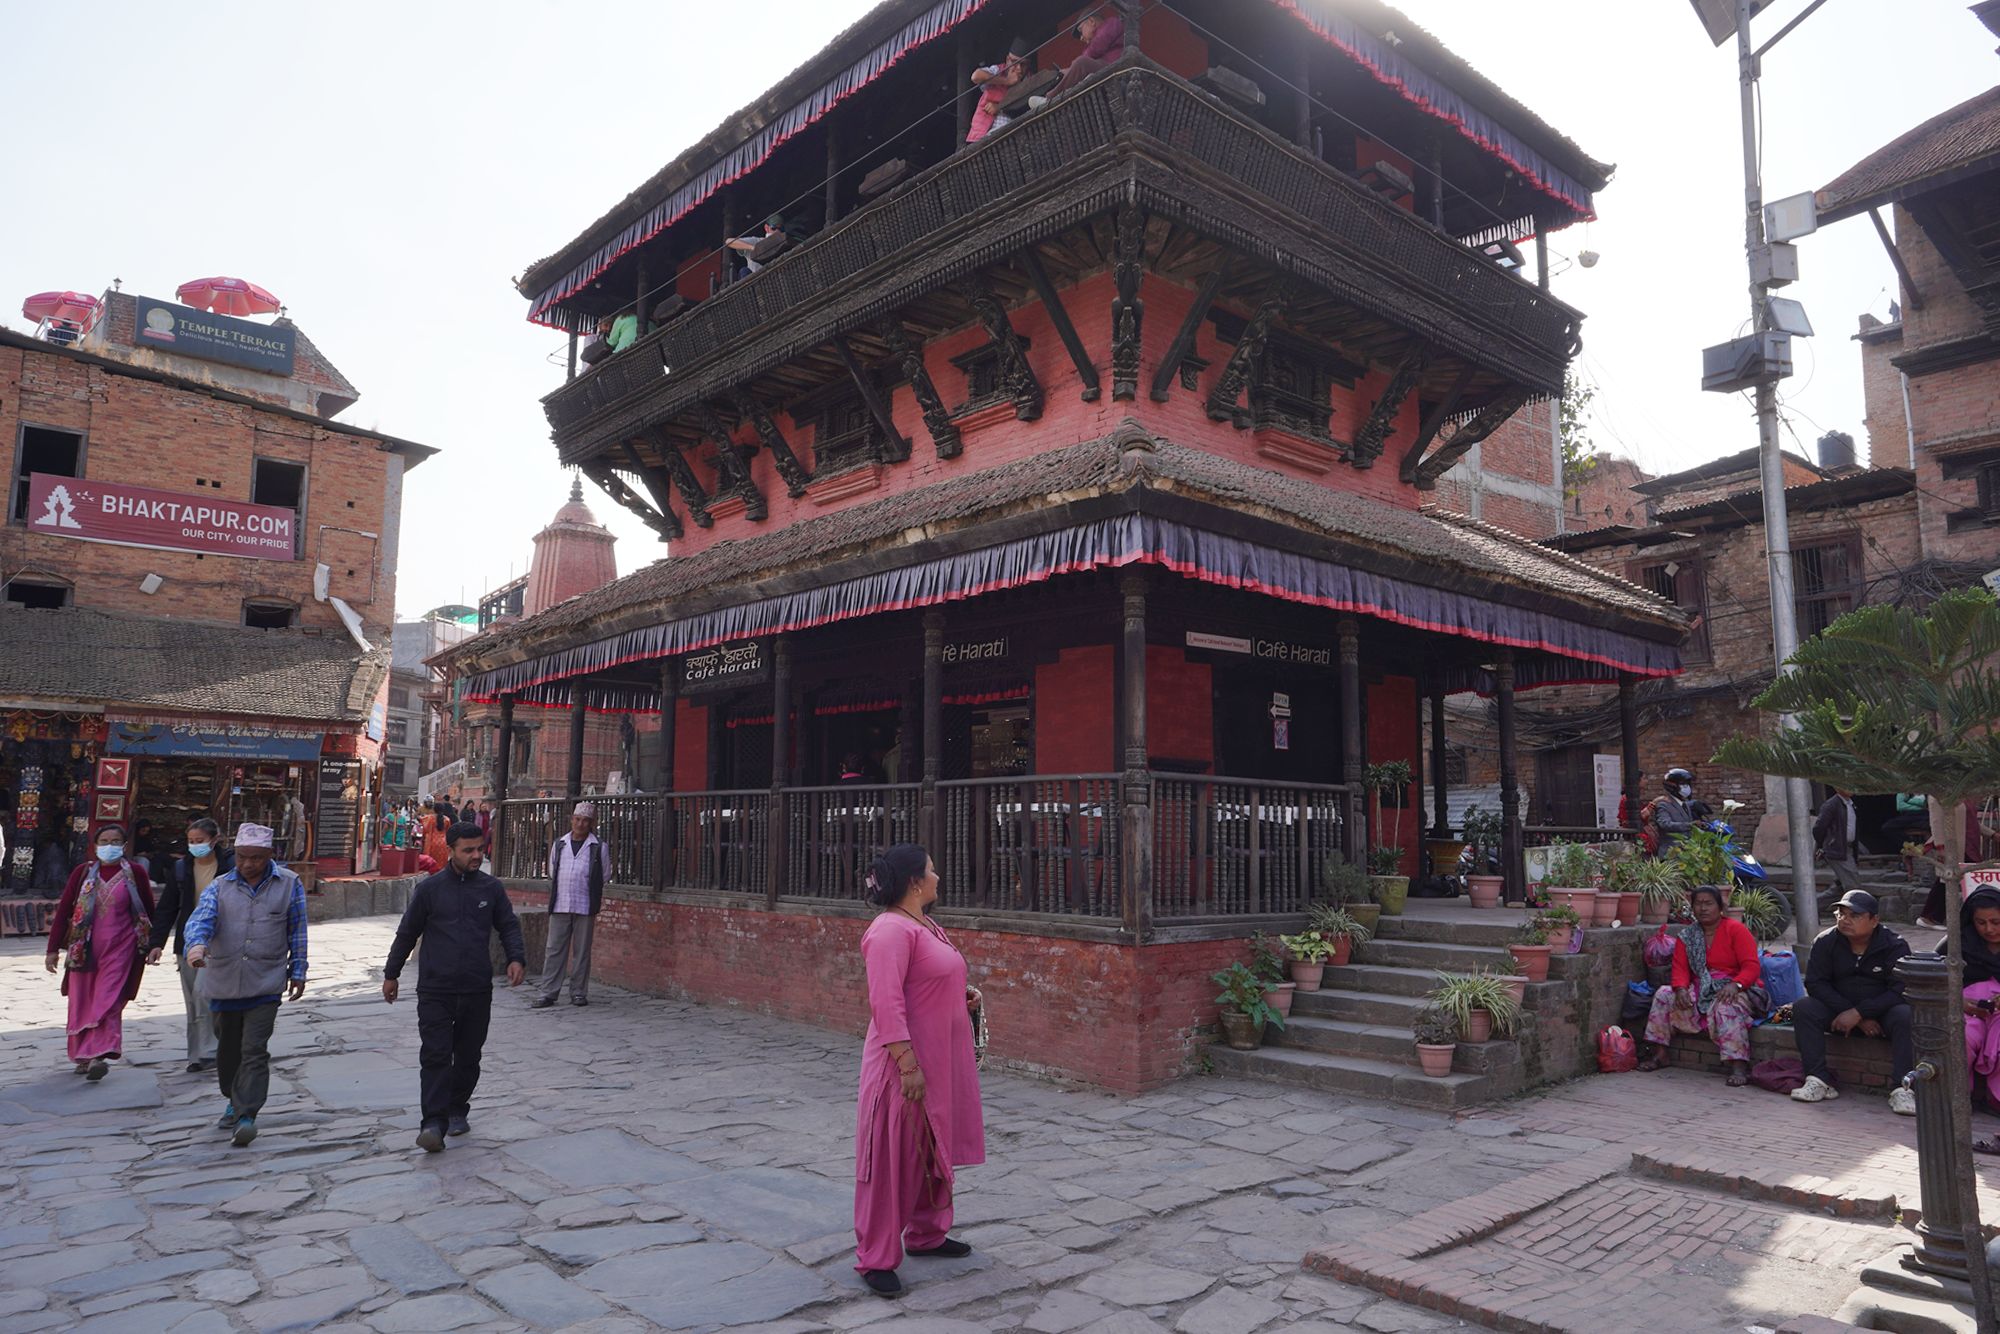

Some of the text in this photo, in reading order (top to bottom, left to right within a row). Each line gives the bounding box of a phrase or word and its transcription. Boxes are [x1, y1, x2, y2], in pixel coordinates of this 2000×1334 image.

[178, 319, 228, 339] TEMPLE
[231, 330, 286, 352] TERRACE
[179, 330, 213, 343] Delicious
[215, 339, 237, 349] meals,
[239, 344, 265, 355] healthy
[267, 350, 286, 359] deals
[102, 494, 289, 537] BHAKTAPUR.COM
[182, 528, 290, 550] OUR CITY, OUR PRIDE
[686, 650, 719, 669] क्याफे
[942, 637, 1005, 663] fè Harati
[1256, 639, 1288, 660] Cafè
[1290, 644, 1331, 665] Harati
[719, 657, 762, 675] Harati
[322, 767, 341, 775] army
